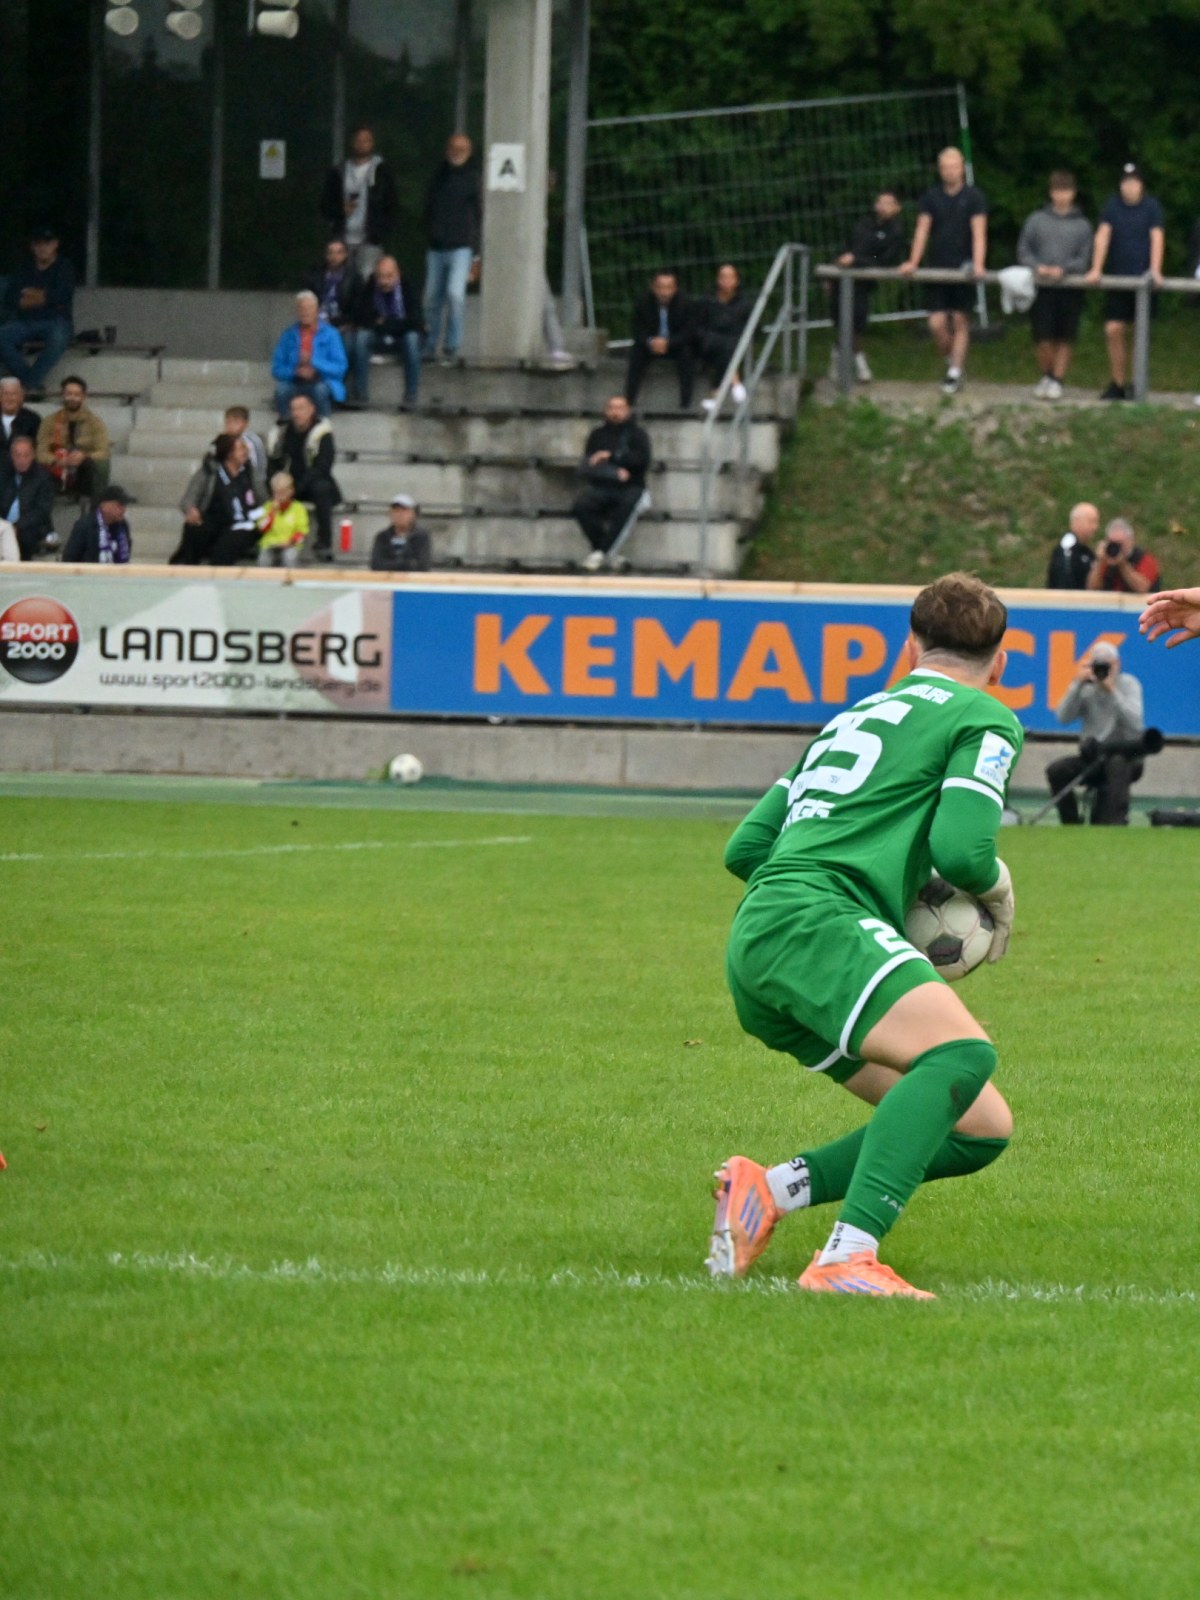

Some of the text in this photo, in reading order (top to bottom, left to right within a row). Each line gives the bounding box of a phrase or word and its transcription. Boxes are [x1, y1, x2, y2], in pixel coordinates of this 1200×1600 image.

[499, 157, 517, 177] A
[1, 622, 73, 641] SPORT
[7, 641, 66, 661] 2000
[100, 625, 383, 668] LANDSBERG
[473, 612, 1128, 711] KEMAPCK
